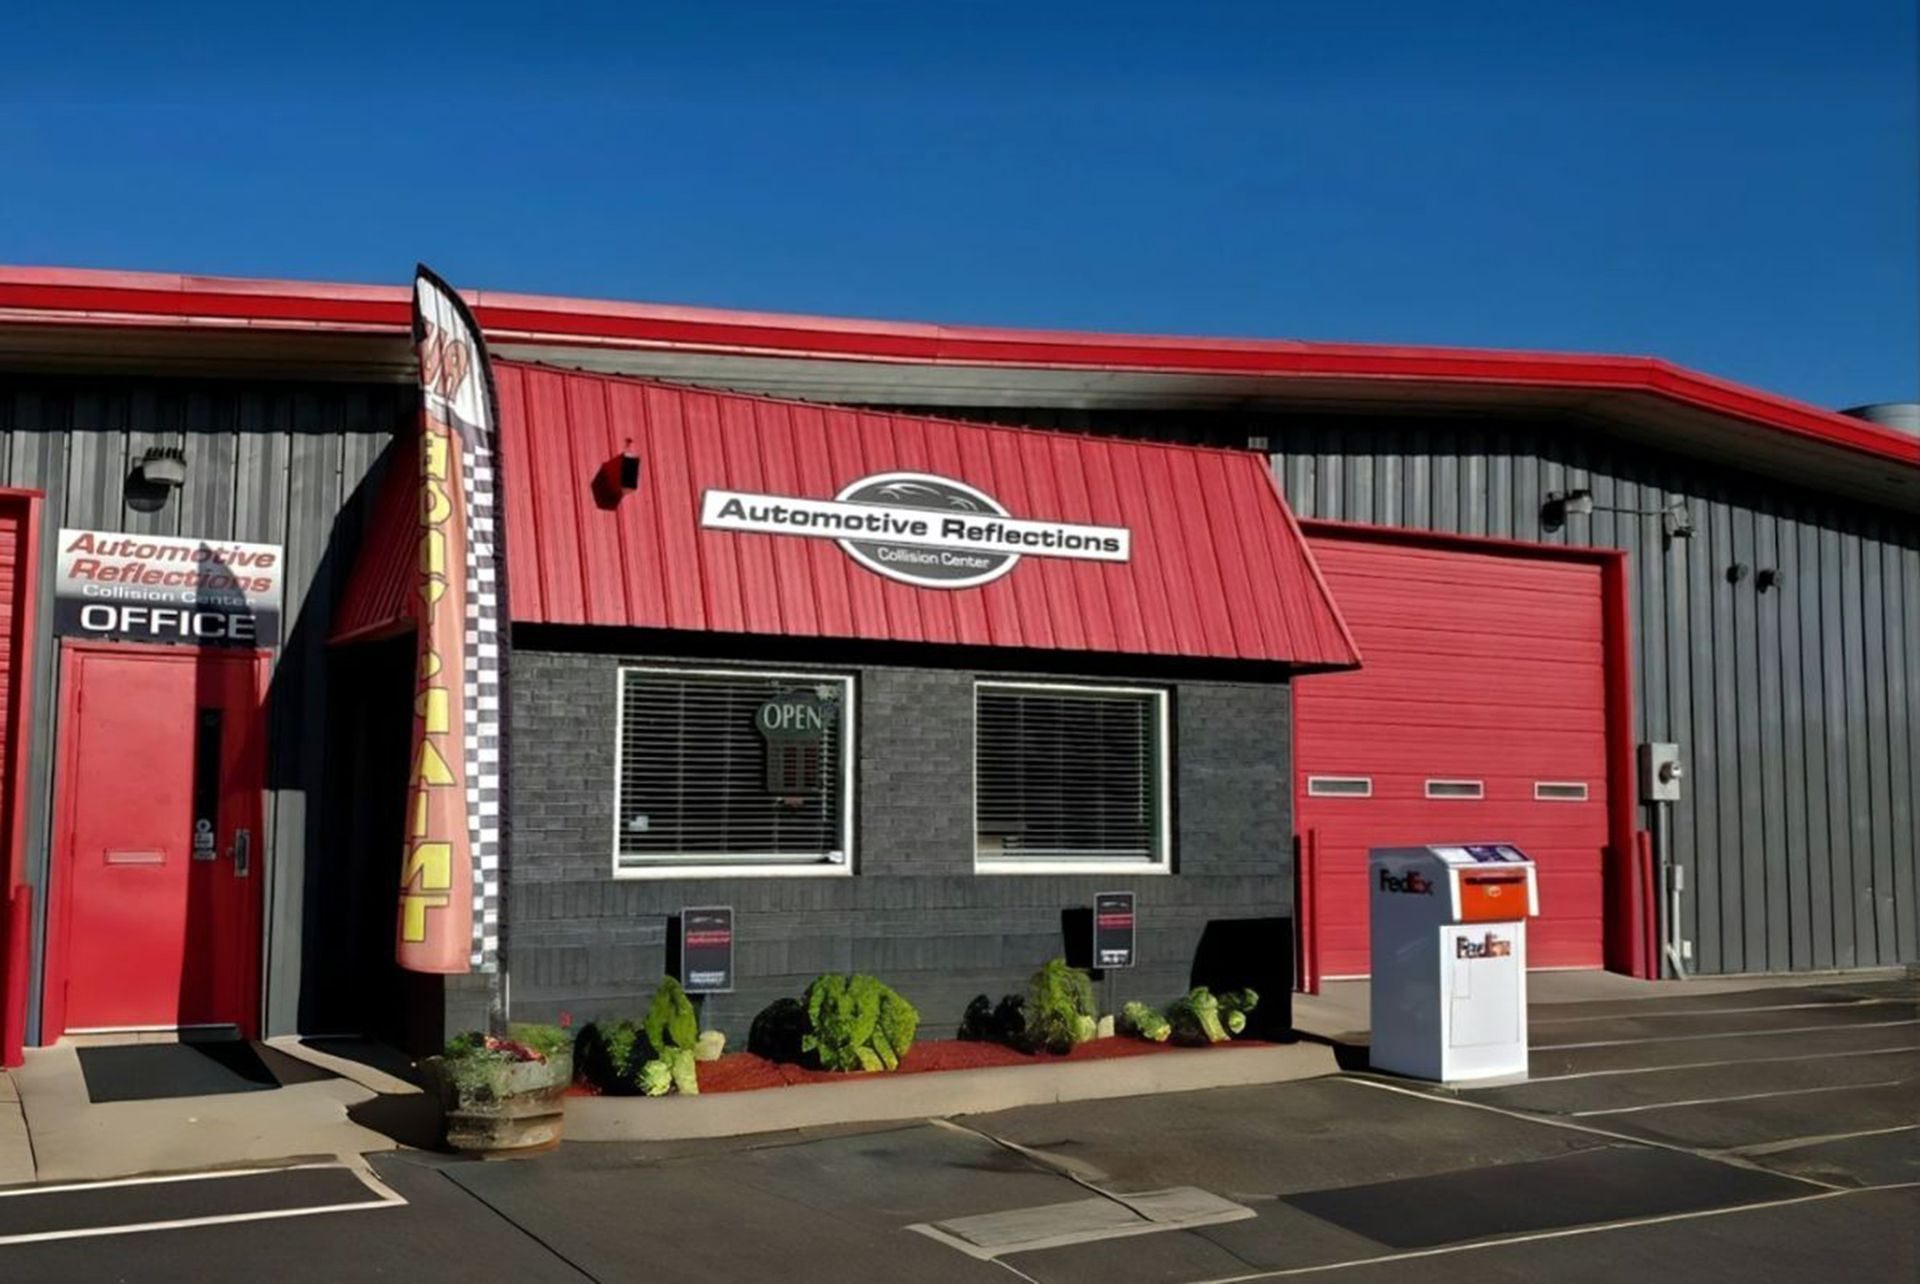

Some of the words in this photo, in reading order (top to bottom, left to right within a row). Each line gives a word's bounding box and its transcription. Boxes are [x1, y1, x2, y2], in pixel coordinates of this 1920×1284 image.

[717, 498, 928, 536] Automotive
[941, 518, 1121, 552] Reflections
[66, 533, 276, 568] Automotive
[877, 547, 939, 565] Collision
[941, 552, 989, 569] Center
[68, 558, 273, 593] Reflections
[82, 584, 175, 602] Collision
[180, 590, 255, 606] Center
[80, 604, 256, 640] OFFICE
[763, 703, 822, 730] OPEN
[1380, 868, 1434, 896] FedEx
